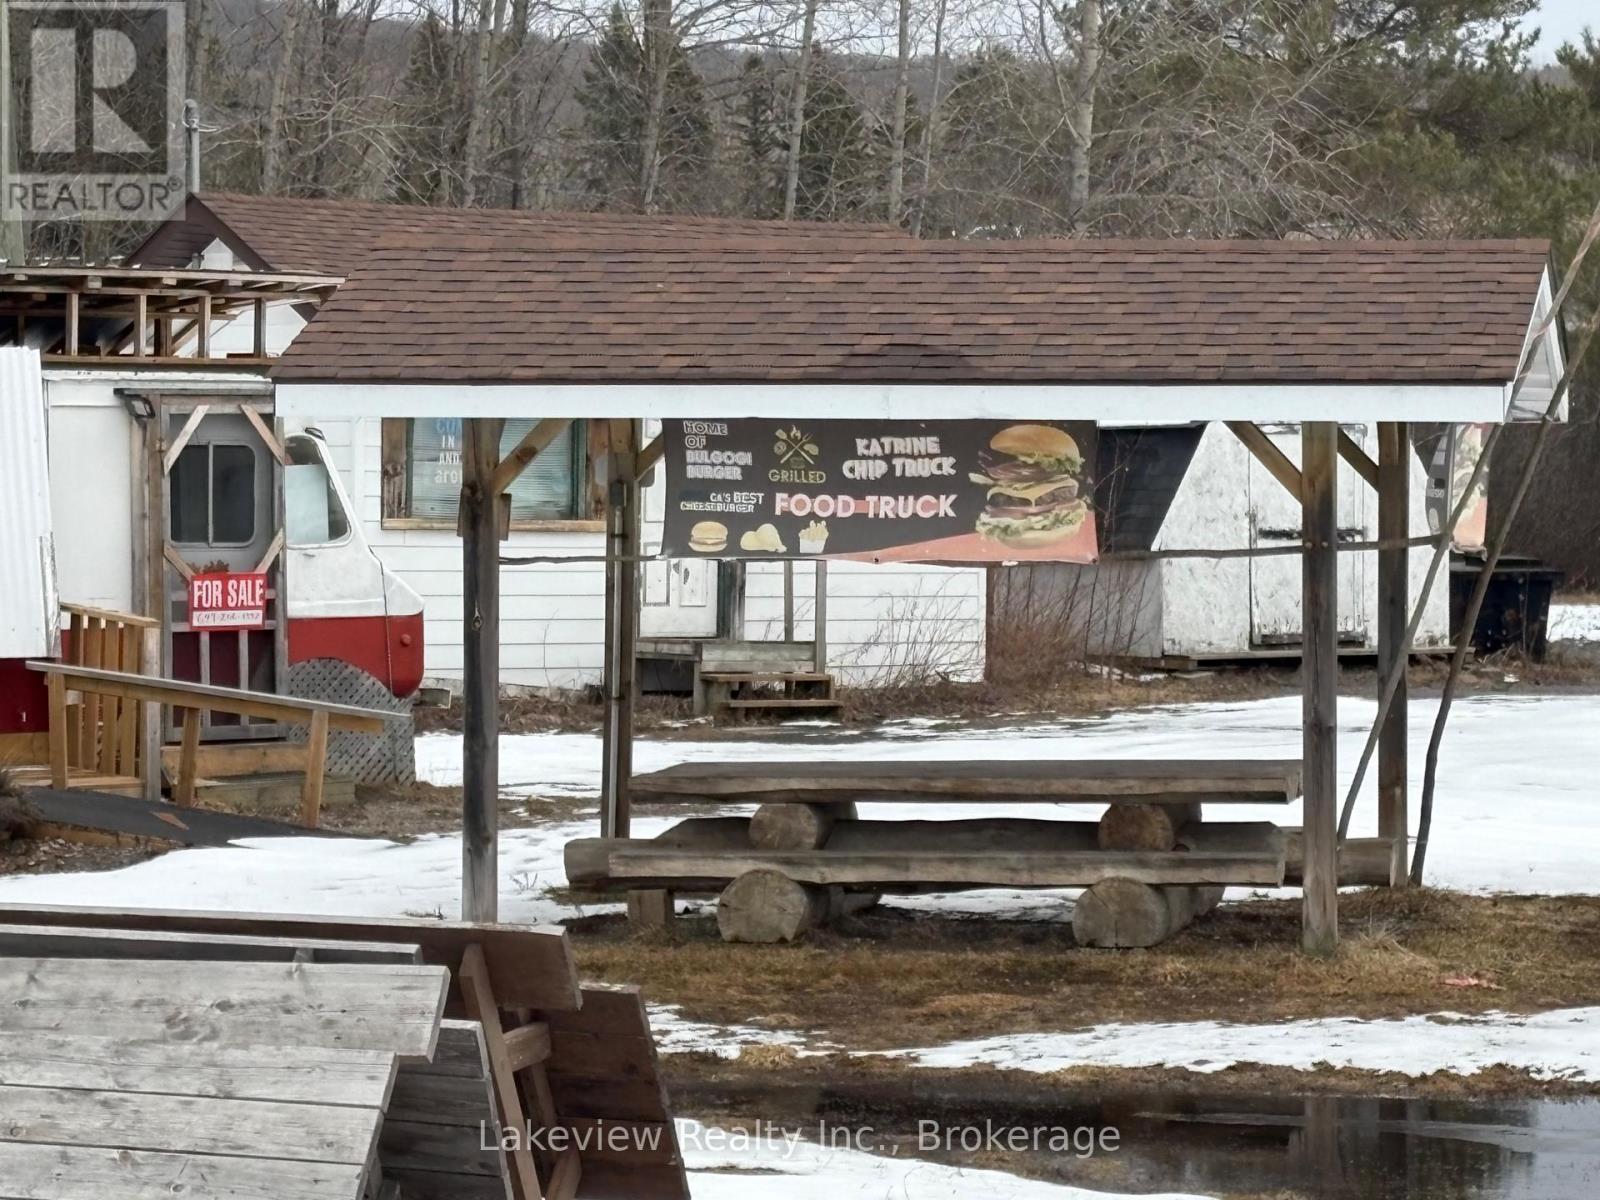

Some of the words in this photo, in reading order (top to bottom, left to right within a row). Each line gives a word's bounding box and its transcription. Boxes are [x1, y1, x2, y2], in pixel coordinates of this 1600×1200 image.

[683, 420, 728, 436] HOME
[442, 435, 455, 449] IN
[684, 435, 707, 449] OF
[855, 436, 941, 457] KATRINE
[439, 452, 460, 465] AND
[686, 465, 743, 481] BURGER
[842, 459, 889, 480] CHIP
[892, 456, 957, 478] TRUCK
[733, 491, 765, 505] BEST
[774, 492, 856, 518] FOOD
[865, 494, 958, 519] TRUCK
[193, 579, 223, 608] FOR
[227, 579, 264, 608] SALE
